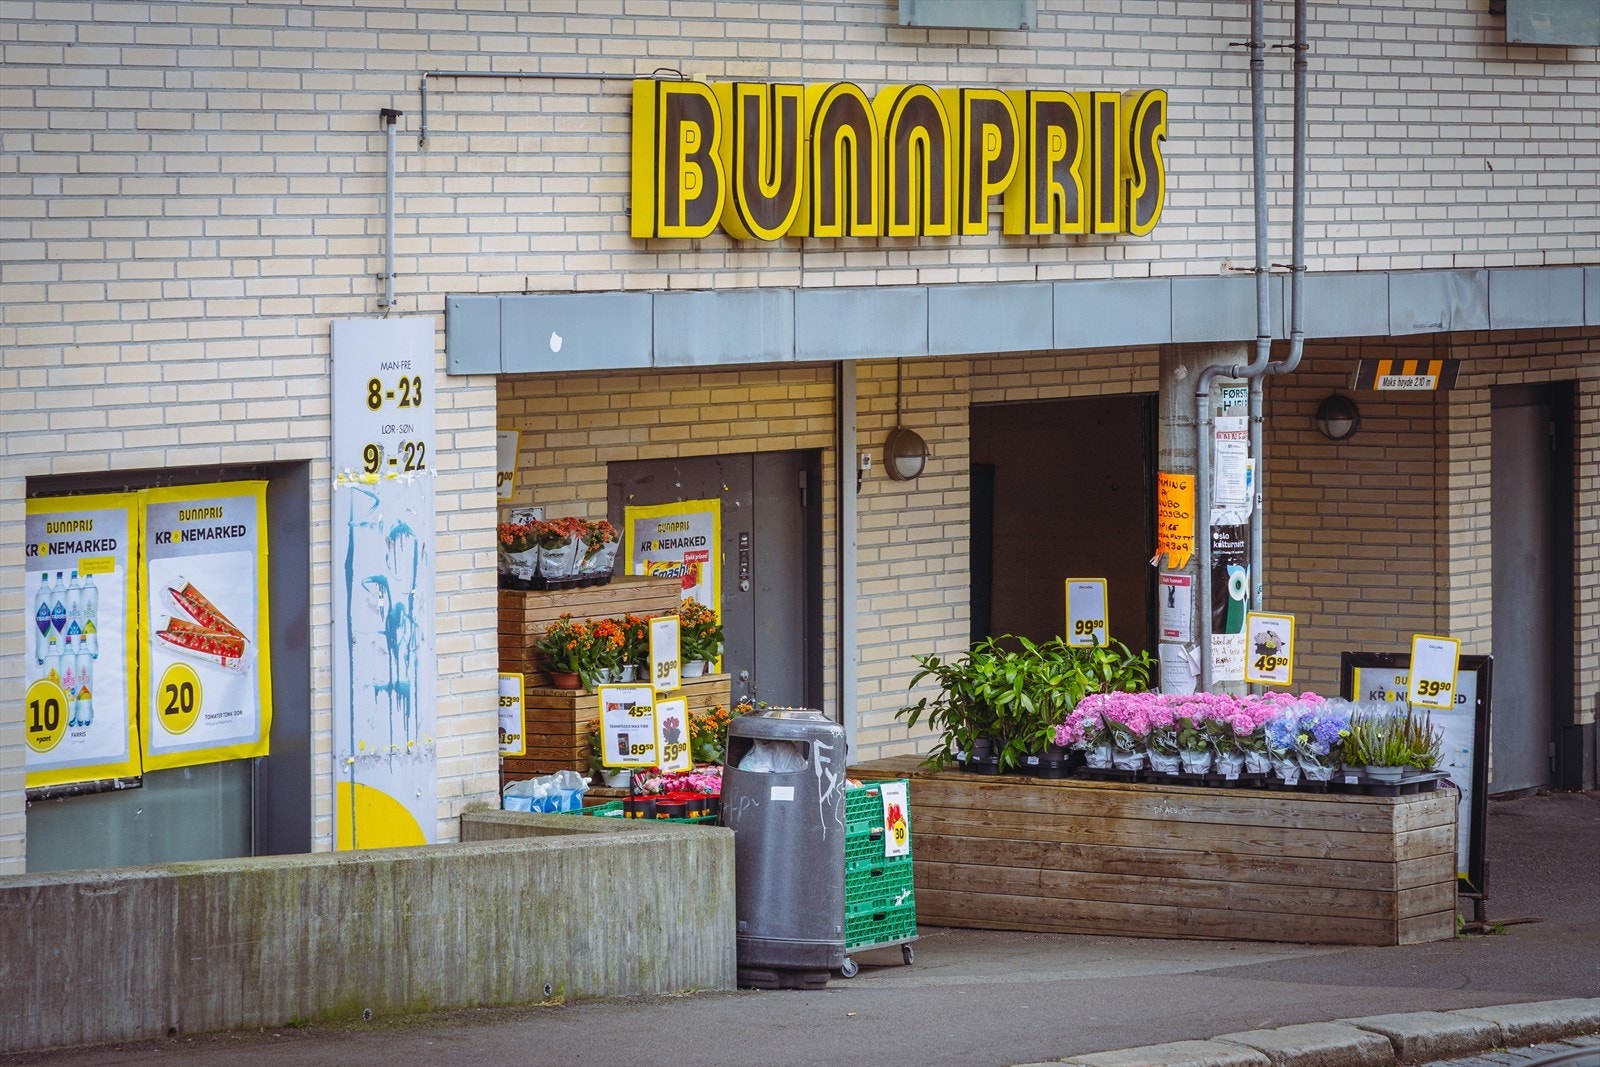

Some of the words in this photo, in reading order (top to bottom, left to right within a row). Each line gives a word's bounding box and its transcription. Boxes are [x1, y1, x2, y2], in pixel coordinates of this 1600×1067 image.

[632, 80, 1168, 241] BUNNPRIS
[1382, 378, 1396, 387] Maks
[178, 506, 223, 522] BUNNPRIS
[46, 519, 94, 535] BUNNPRIS
[1213, 532, 1230, 540] Oslo
[165, 682, 194, 716] 20
[30, 698, 60, 733] 10
[895, 828, 905, 840] 30
